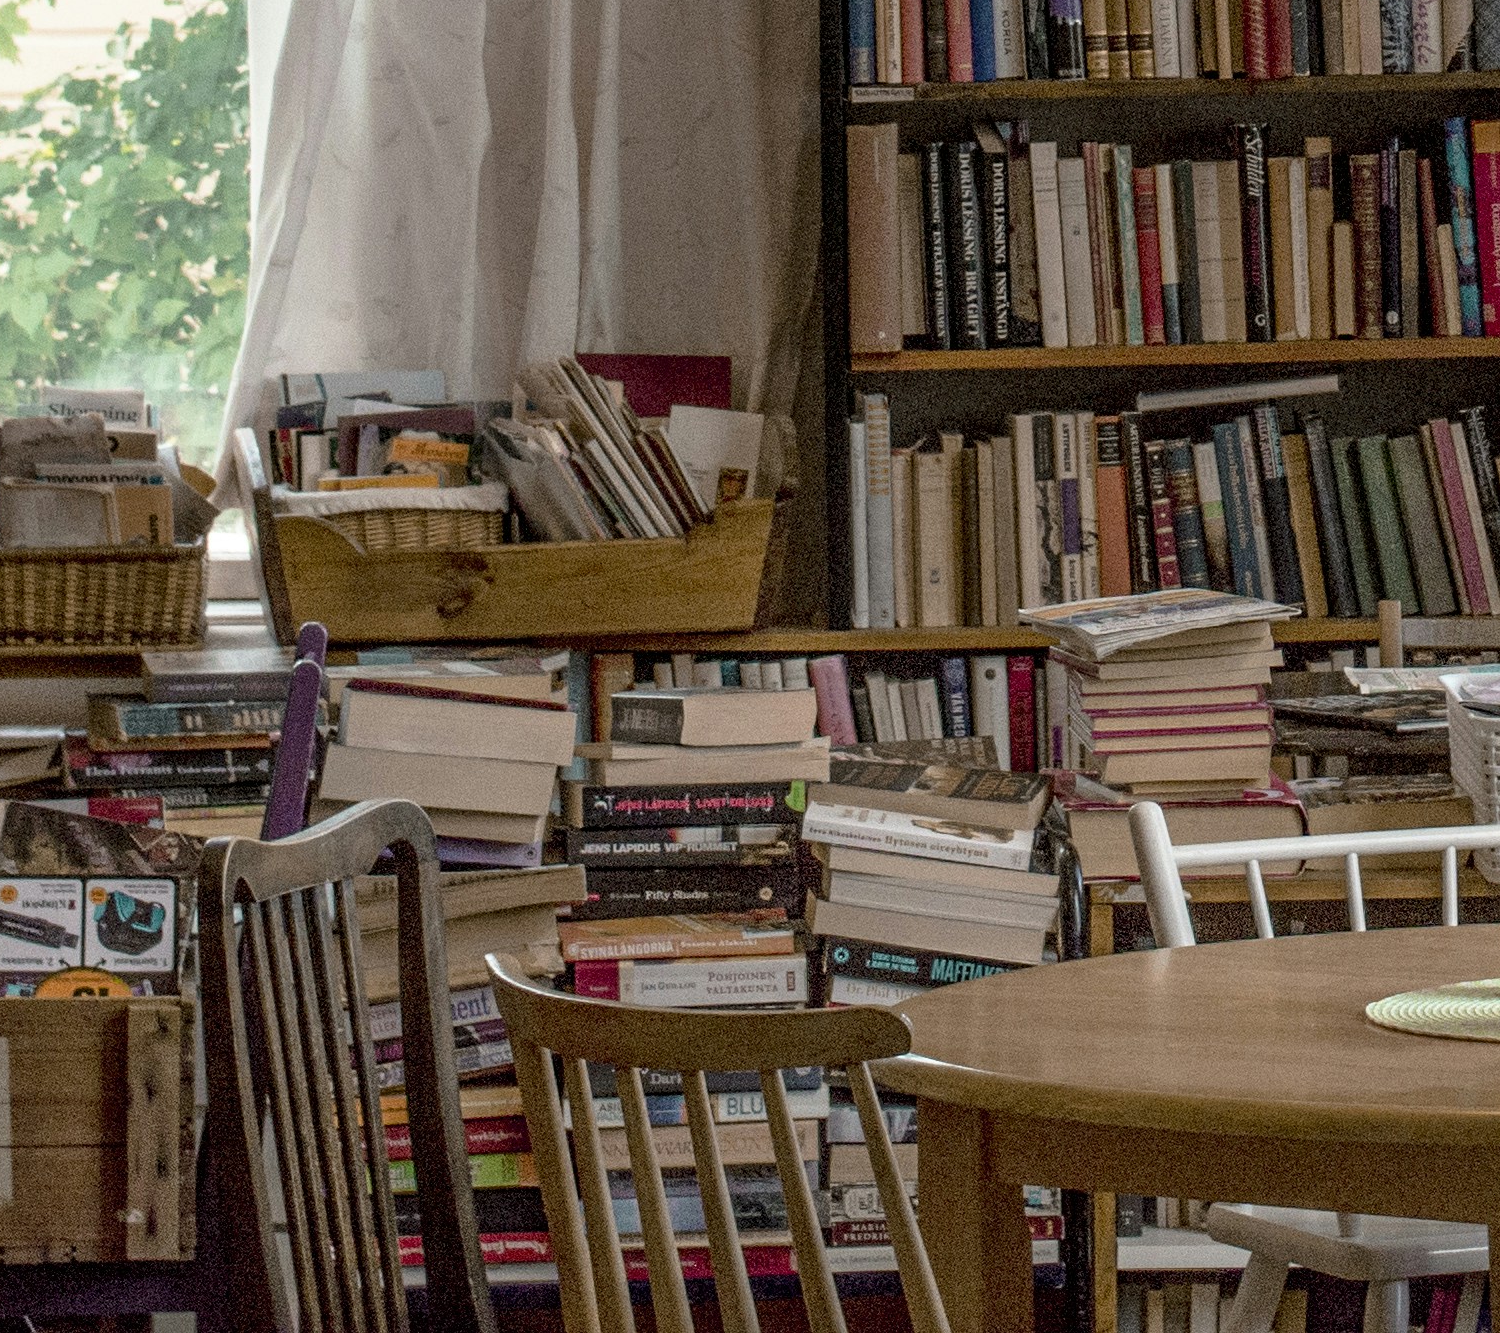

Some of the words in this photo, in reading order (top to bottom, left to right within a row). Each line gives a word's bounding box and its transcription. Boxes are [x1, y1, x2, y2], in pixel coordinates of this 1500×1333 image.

[1002, 10, 1013, 56] KORDA
[958, 152, 975, 198] DORIS
[992, 161, 1008, 205] DORIS
[960, 201, 977, 261] LESSING
[993, 207, 1008, 264] LESSING
[964, 271, 979, 298] BRA
[965, 301, 981, 339] GIFT
[994, 271, 1011, 339] INSTÄNGD
[615, 797, 642, 812] JENS
[644, 796, 690, 811] LAPIDUS
[695, 795, 726, 811] LIVET
[581, 842, 611, 856] JENS
[614, 842, 661, 855] LAPIDUS
[644, 889, 671, 903] Fifty
[674, 888, 708, 900] Shades
[640, 980, 656, 992] JAN
[705, 984, 778, 996] VALTAKUNTA
[706, 971, 776, 985] POHJOINEN
